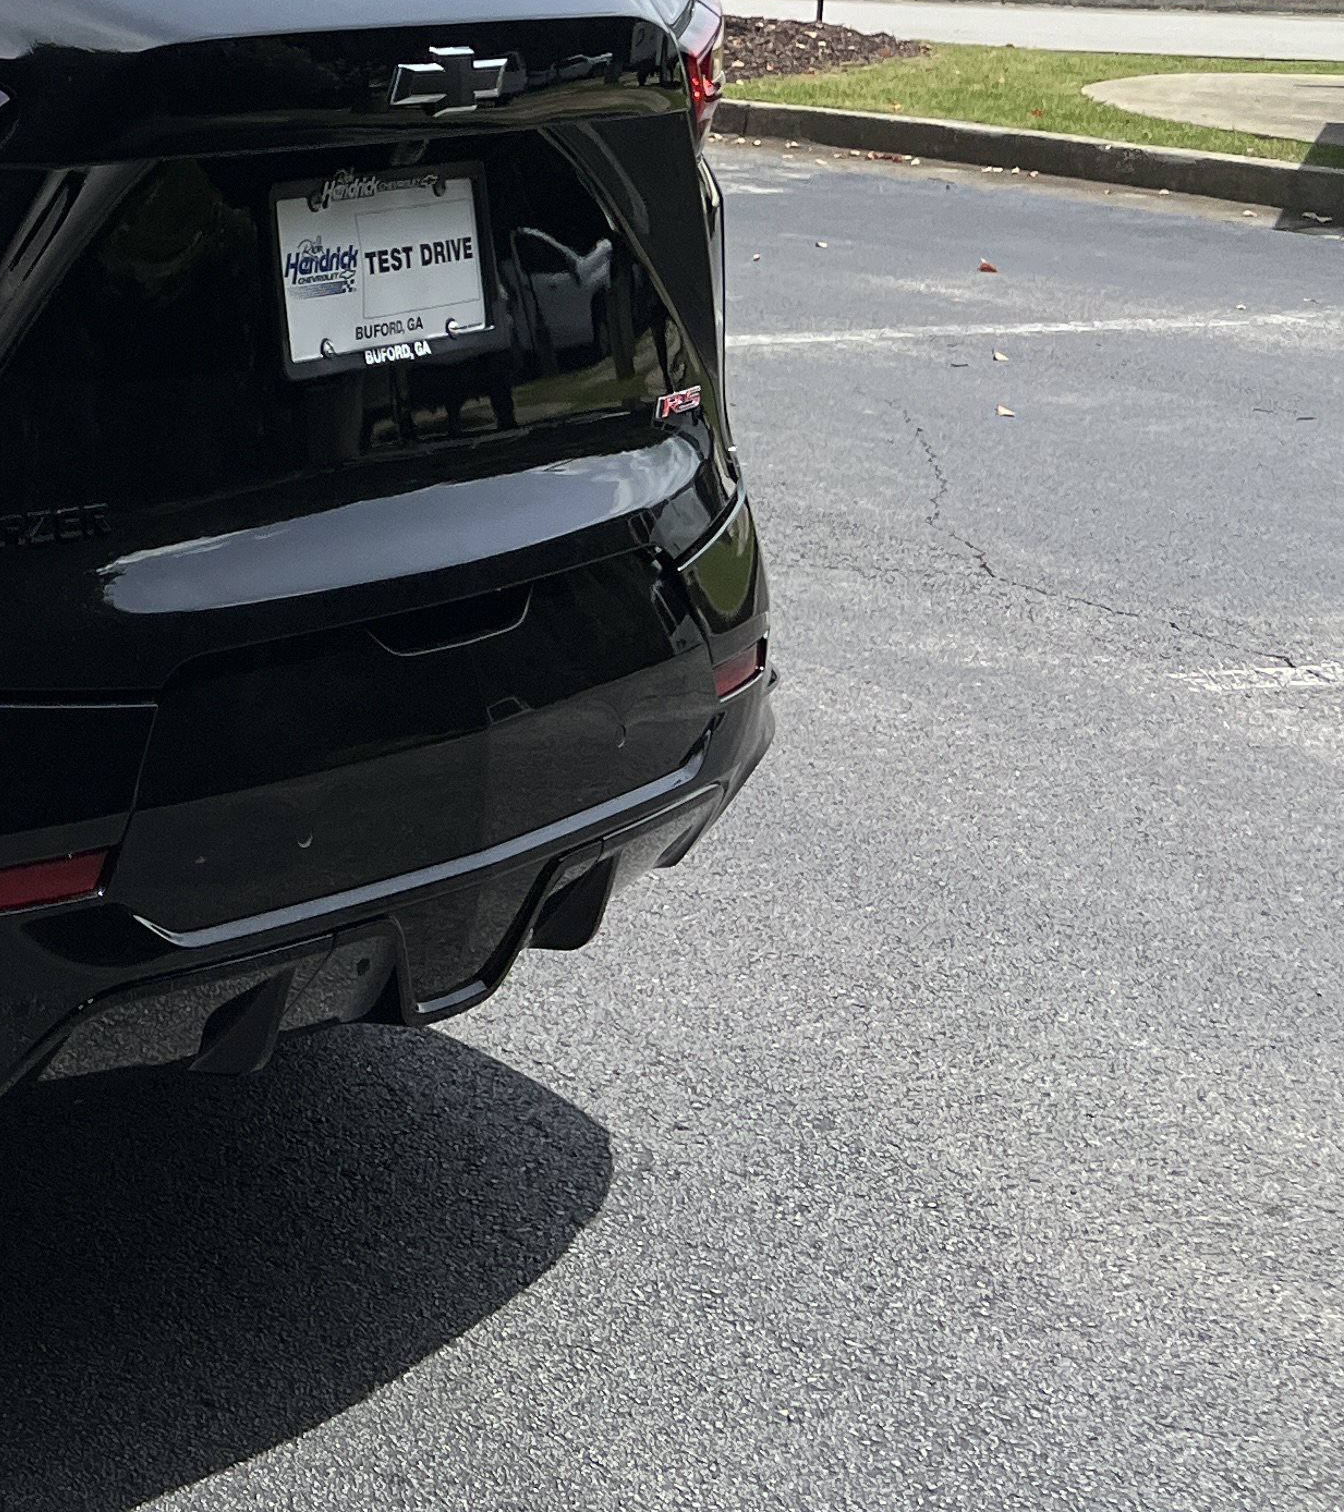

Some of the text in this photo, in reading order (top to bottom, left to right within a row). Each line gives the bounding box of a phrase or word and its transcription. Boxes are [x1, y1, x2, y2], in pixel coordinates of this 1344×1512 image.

[285, 245, 358, 284] Hendrick
[364, 237, 472, 275] TEST DRIVE
[355, 316, 423, 341] BUFORD, GA
[365, 340, 432, 365] BUFORD, GA
